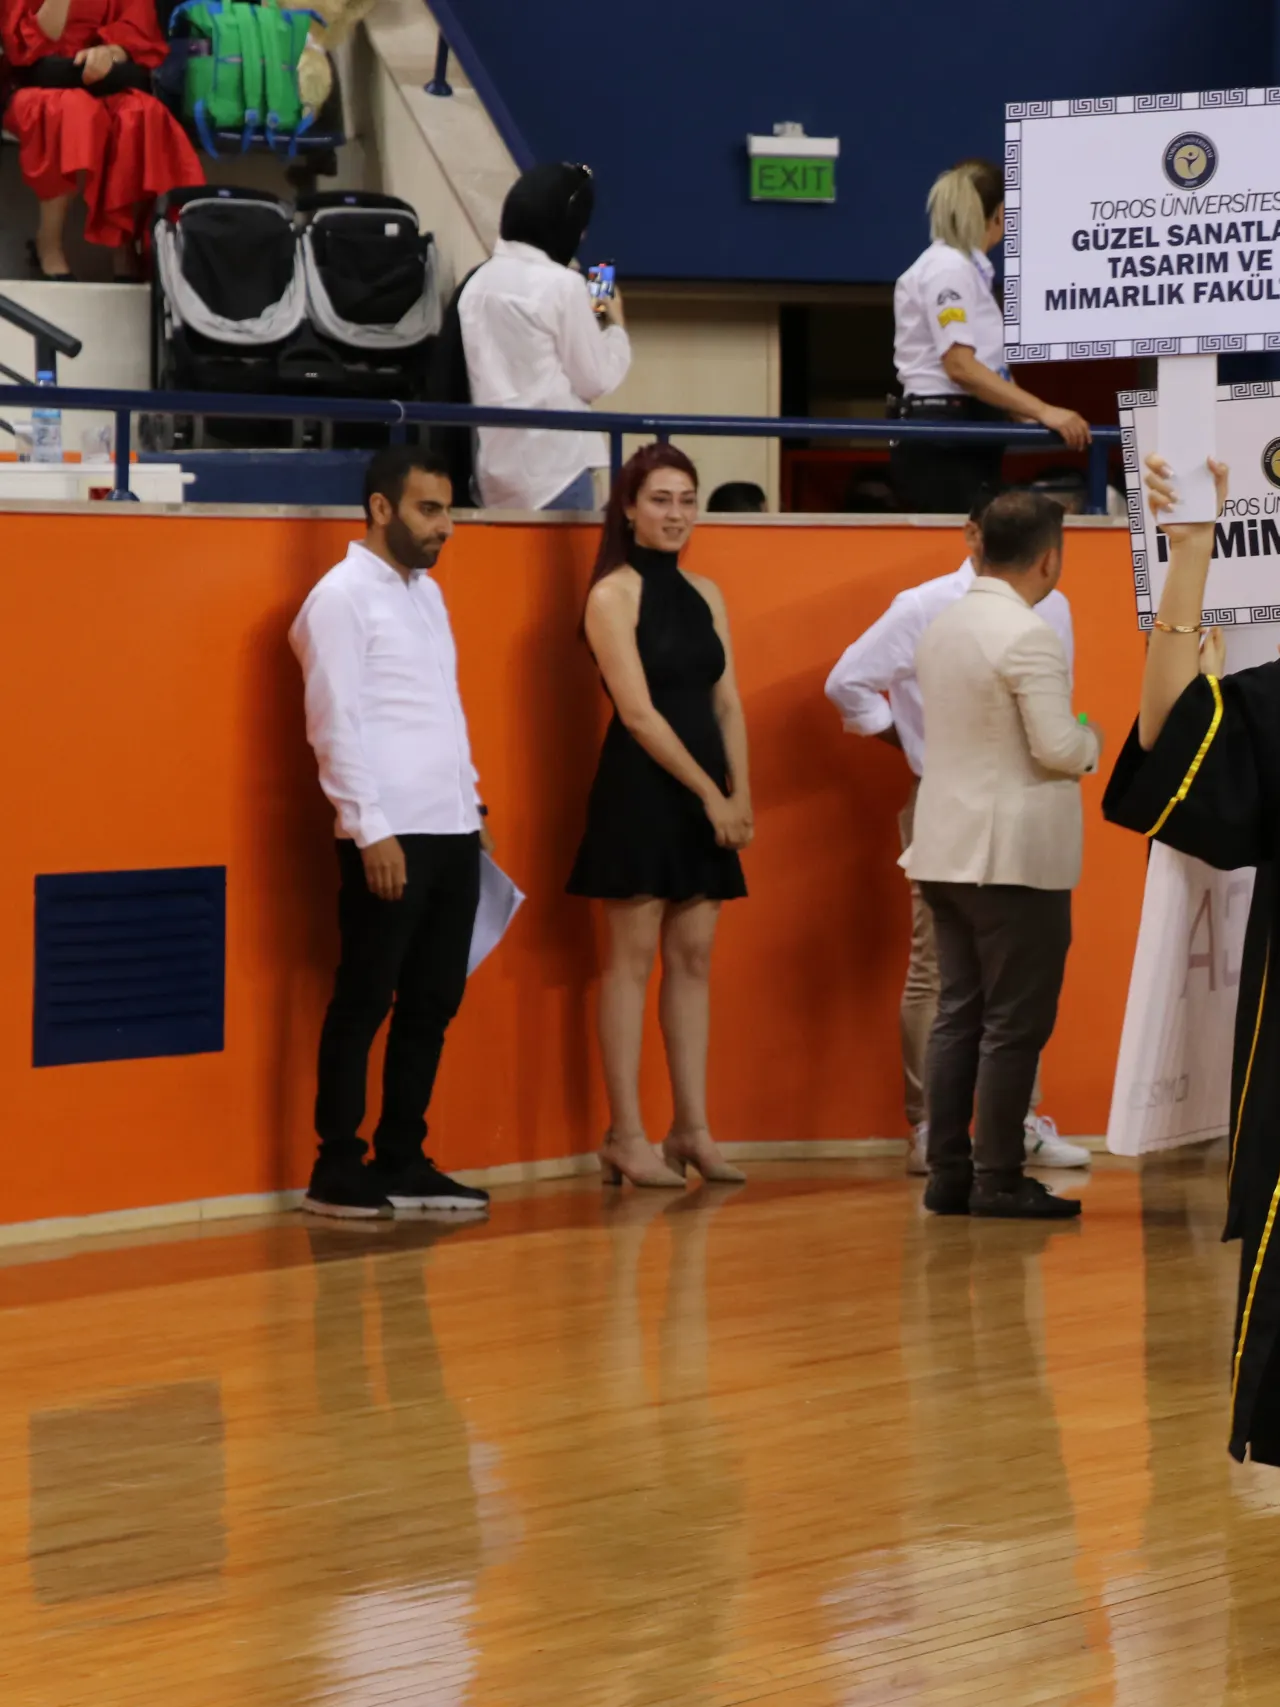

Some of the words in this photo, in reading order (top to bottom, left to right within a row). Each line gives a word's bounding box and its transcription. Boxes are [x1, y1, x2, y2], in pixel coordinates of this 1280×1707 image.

[757, 164, 829, 193] EXIT
[1090, 198, 1157, 220] TOROS
[1072, 223, 1160, 252] GÜZEL
[1107, 251, 1229, 279] TASARIM
[1237, 249, 1273, 272] VE
[1045, 282, 1185, 311] MİMARLIK
